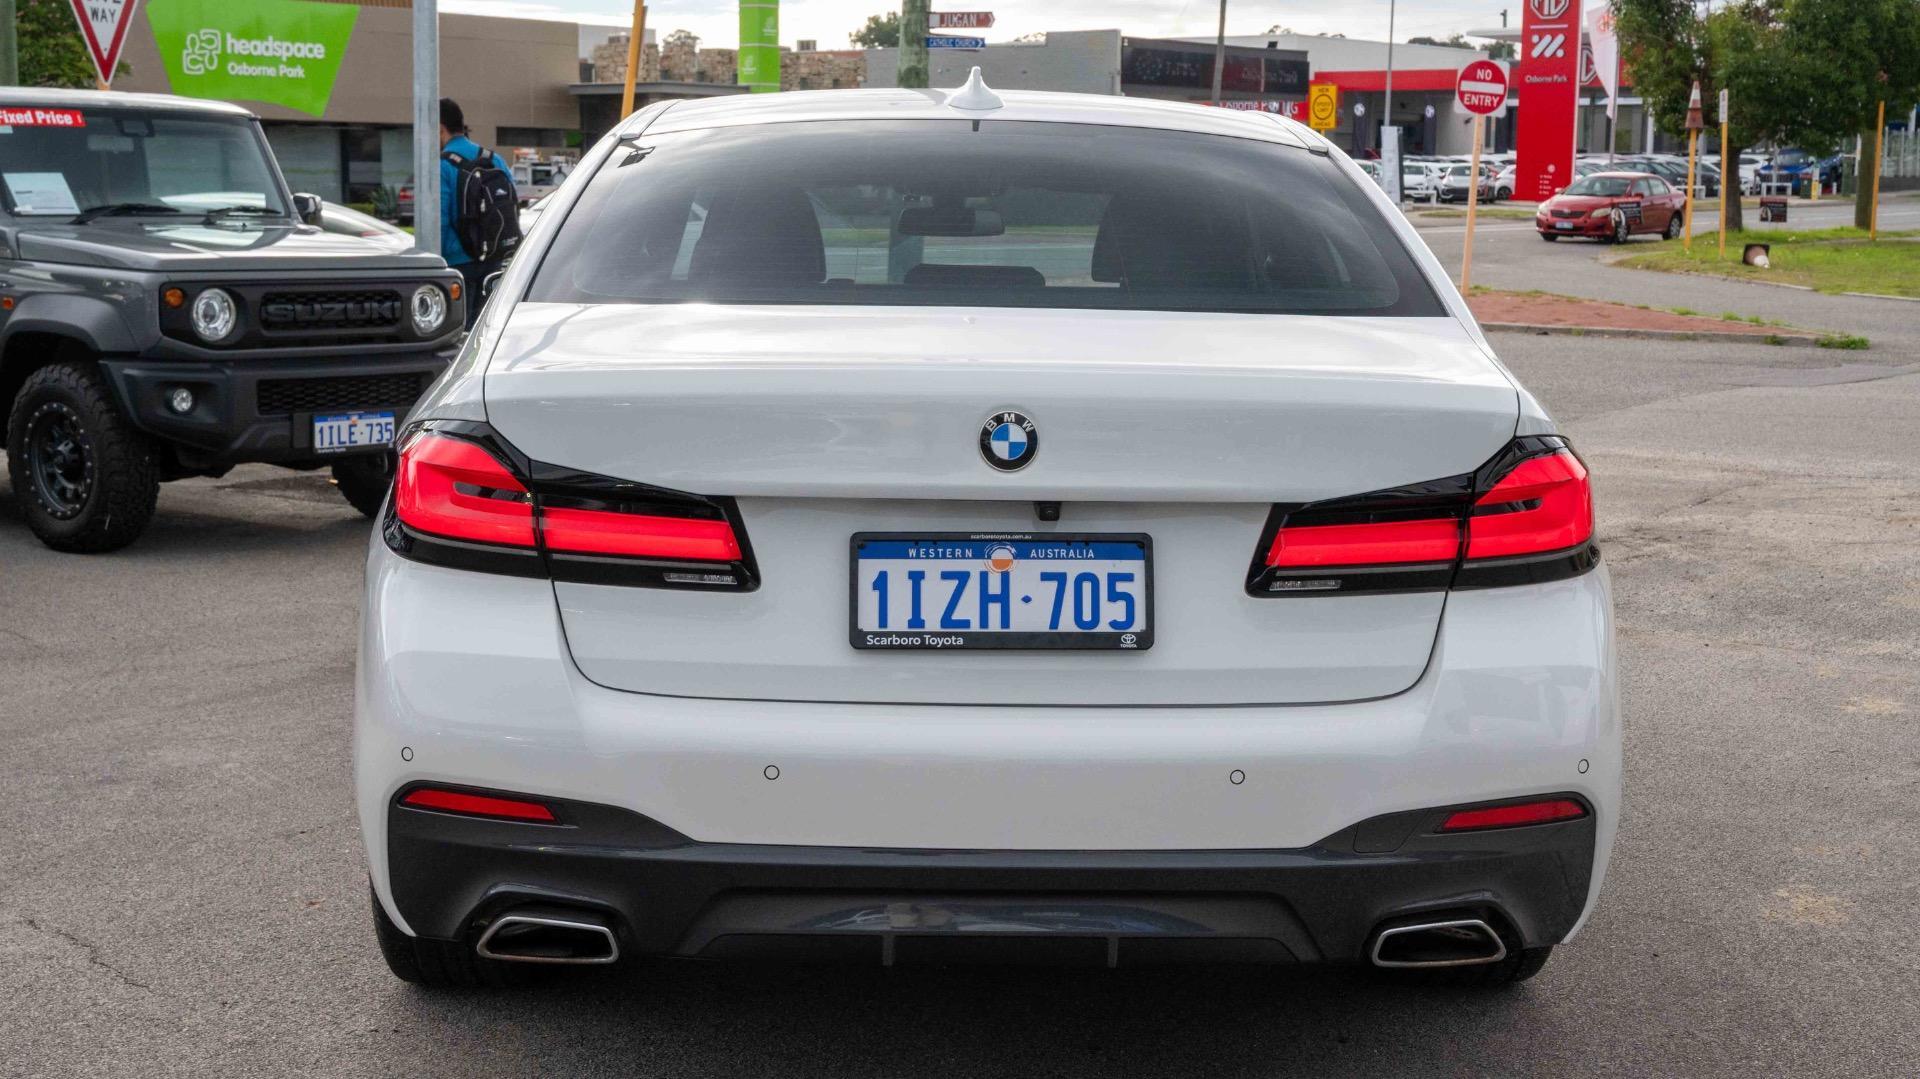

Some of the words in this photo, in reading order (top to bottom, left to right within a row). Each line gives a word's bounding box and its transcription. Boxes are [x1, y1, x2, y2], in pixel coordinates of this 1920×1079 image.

[90, 7, 116, 23] WAY
[941, 13, 977, 27] JUGAN
[226, 32, 326, 62] headspace
[227, 61, 277, 77] Osborne
[279, 64, 305, 78] Park
[1476, 69, 1492, 81] NO
[1525, 74, 1552, 83] Osborne
[1553, 74, 1568, 83] Park
[1464, 93, 1500, 107] ENTRY
[35, 110, 73, 125] Price
[261, 302, 400, 322] SUZUKI
[985, 413, 1035, 433] BMW
[908, 548, 973, 559] WESTERN
[1030, 549, 1095, 559] AUSTRALIA
[866, 634, 921, 646] Scarboro
[923, 635, 964, 648] Toyota
